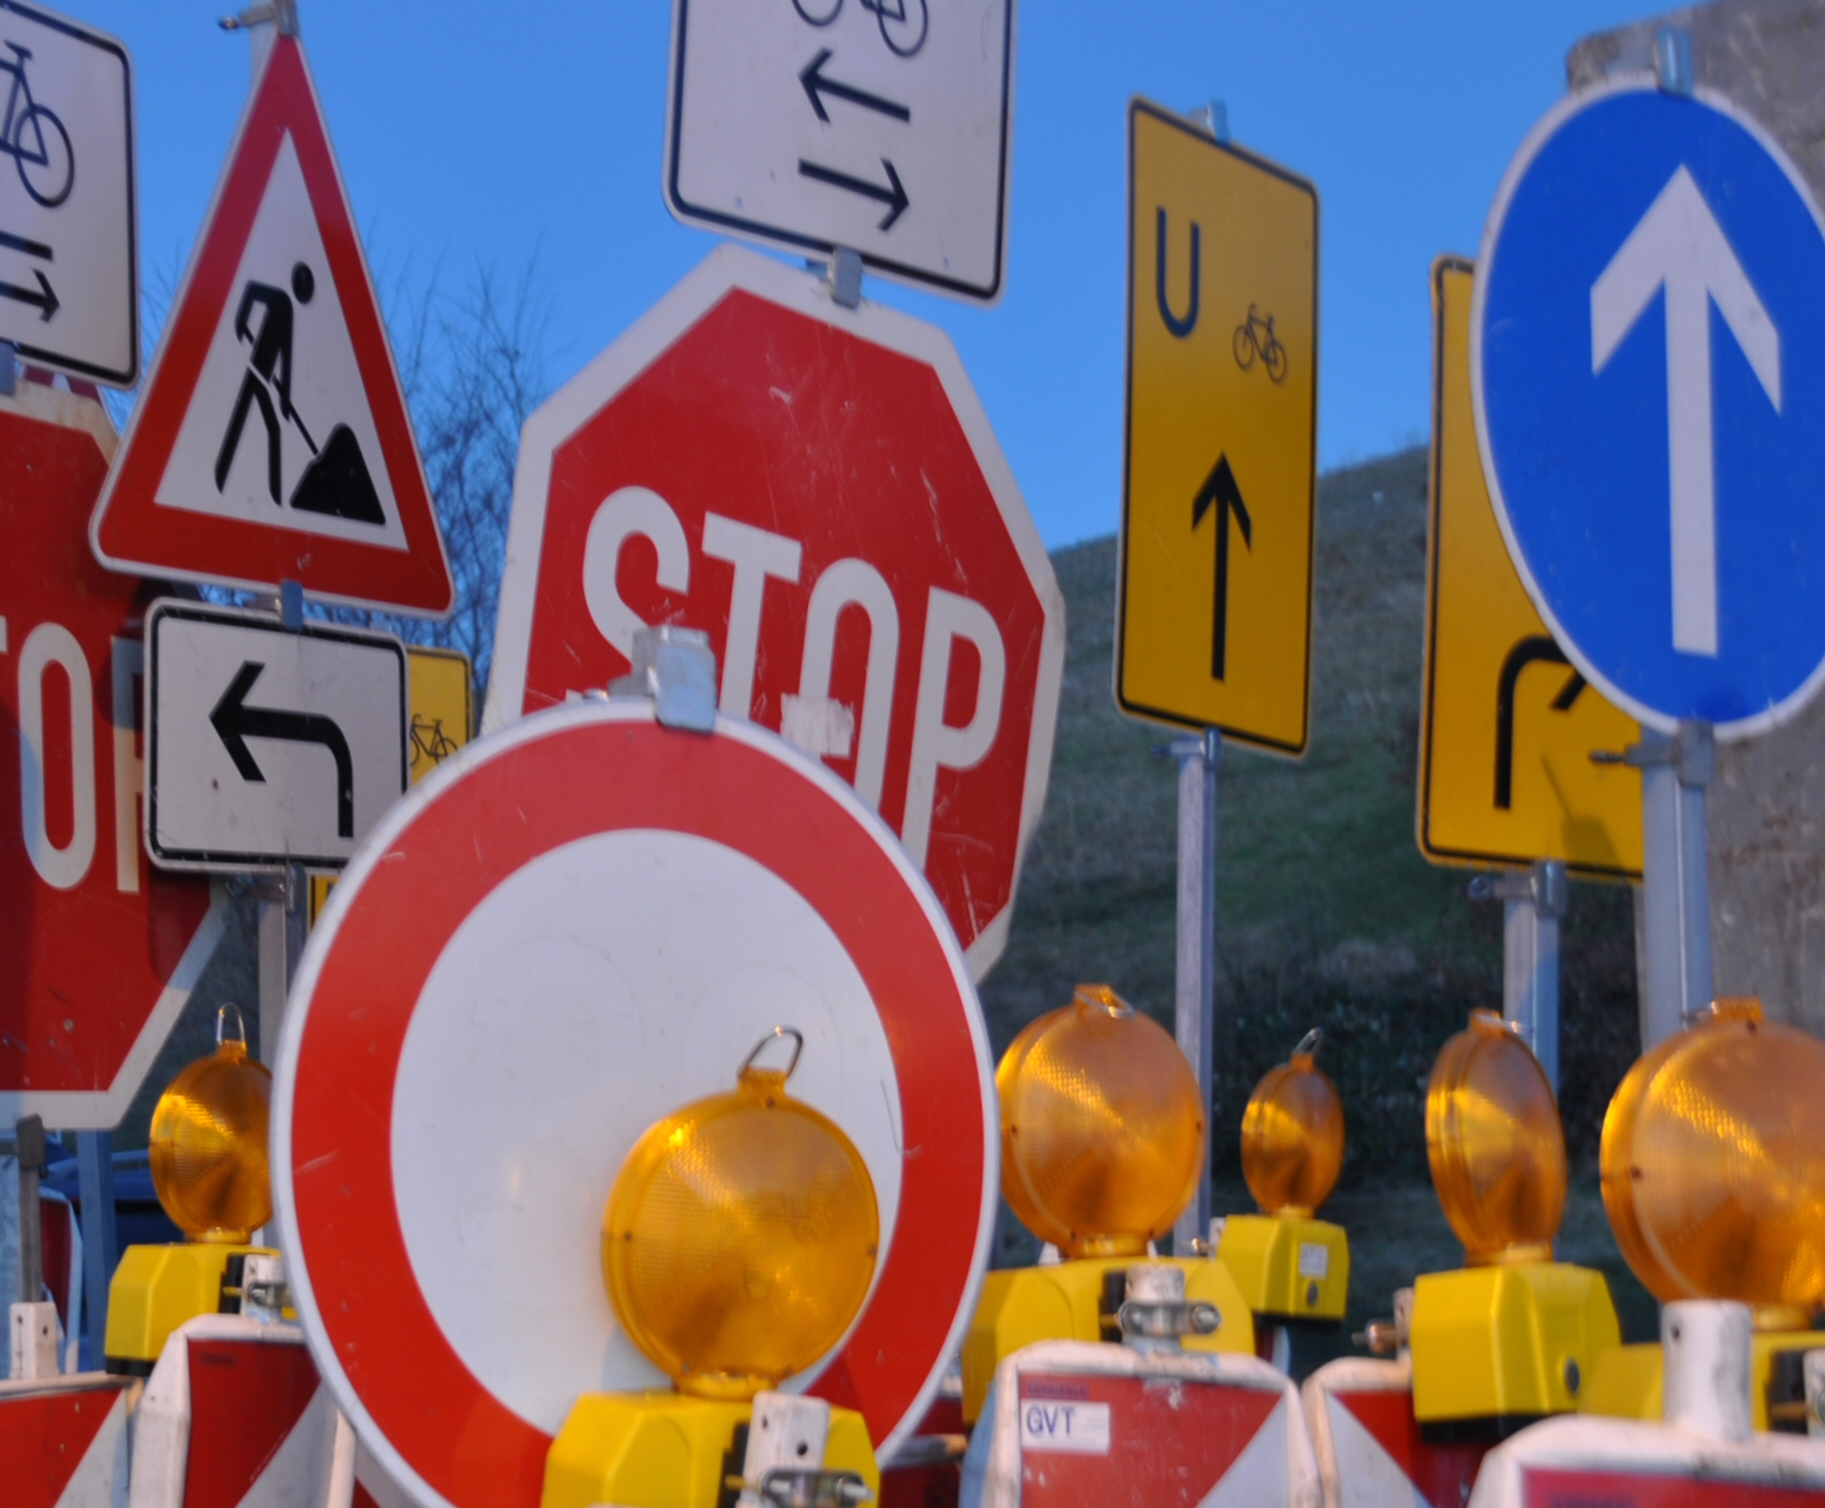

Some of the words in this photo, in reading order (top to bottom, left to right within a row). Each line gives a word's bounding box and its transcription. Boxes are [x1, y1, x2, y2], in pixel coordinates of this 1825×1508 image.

[1156, 204, 1201, 339] U
[566, 484, 1006, 873] STOP
[1026, 1404, 1076, 1438] GVT
